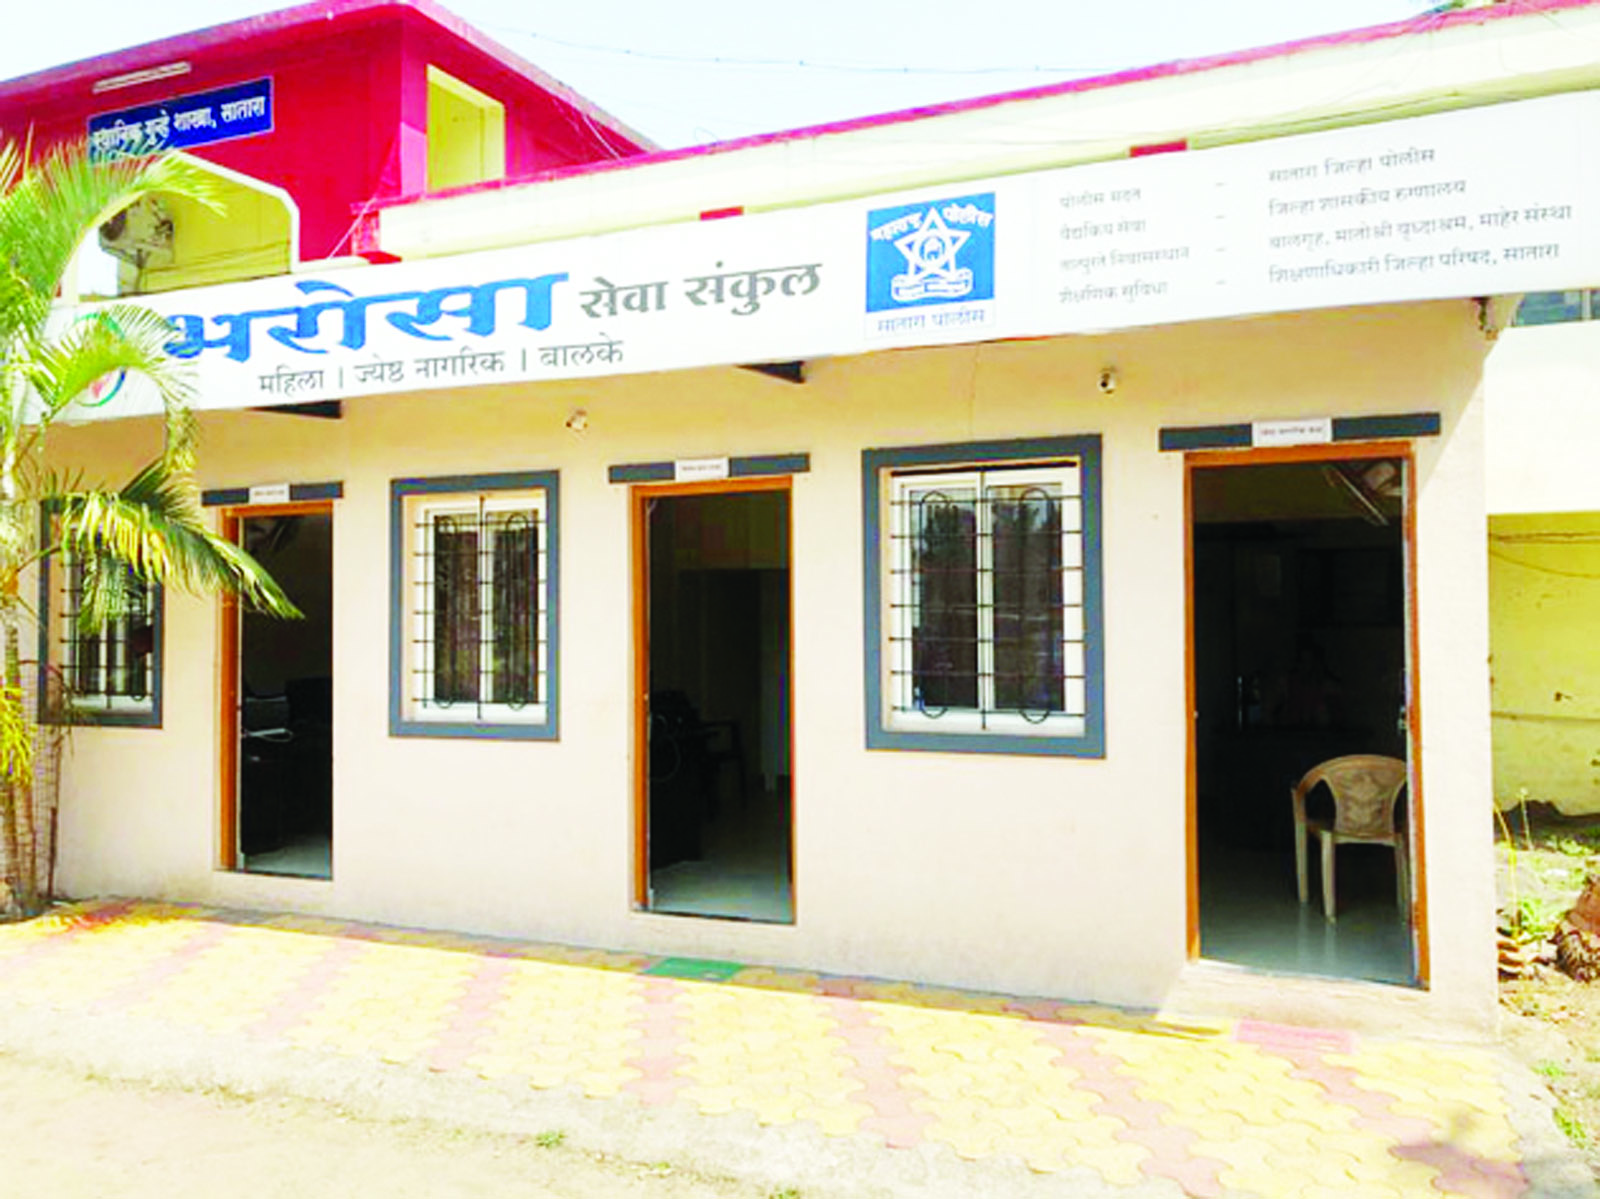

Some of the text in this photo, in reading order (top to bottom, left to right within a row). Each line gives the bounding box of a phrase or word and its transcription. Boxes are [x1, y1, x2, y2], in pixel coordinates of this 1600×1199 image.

[220, 95, 266, 123] सातारा
[1269, 164, 1318, 181] सातारा
[1324, 157, 1372, 175] जिल्हा
[1379, 147, 1436, 167] पोलीस
[1268, 198, 1314, 216] जिल्हा
[1319, 187, 1390, 211] शासकीय
[1395, 178, 1466, 200] रुग्णालय
[1270, 231, 1330, 252] बालगृह,
[1335, 220, 1392, 241] मातोश्री
[1479, 205, 1519, 228] माहेर
[1524, 202, 1572, 223] संस्था
[1268, 256, 1380, 283] शिक्षणाधिकारी
[1385, 255, 1433, 272] जिल्हा
[1439, 246, 1497, 266] परिषद,
[1503, 243, 1559, 261] सातारा
[163, 272, 569, 363] भरोसा
[579, 276, 669, 319] सेवा
[684, 260, 823, 317] संकुल
[257, 363, 326, 396] महिला
[353, 353, 405, 386] ज्येष्ठ
[413, 345, 505, 380] नागरिक
[538, 332, 625, 369] बालके
